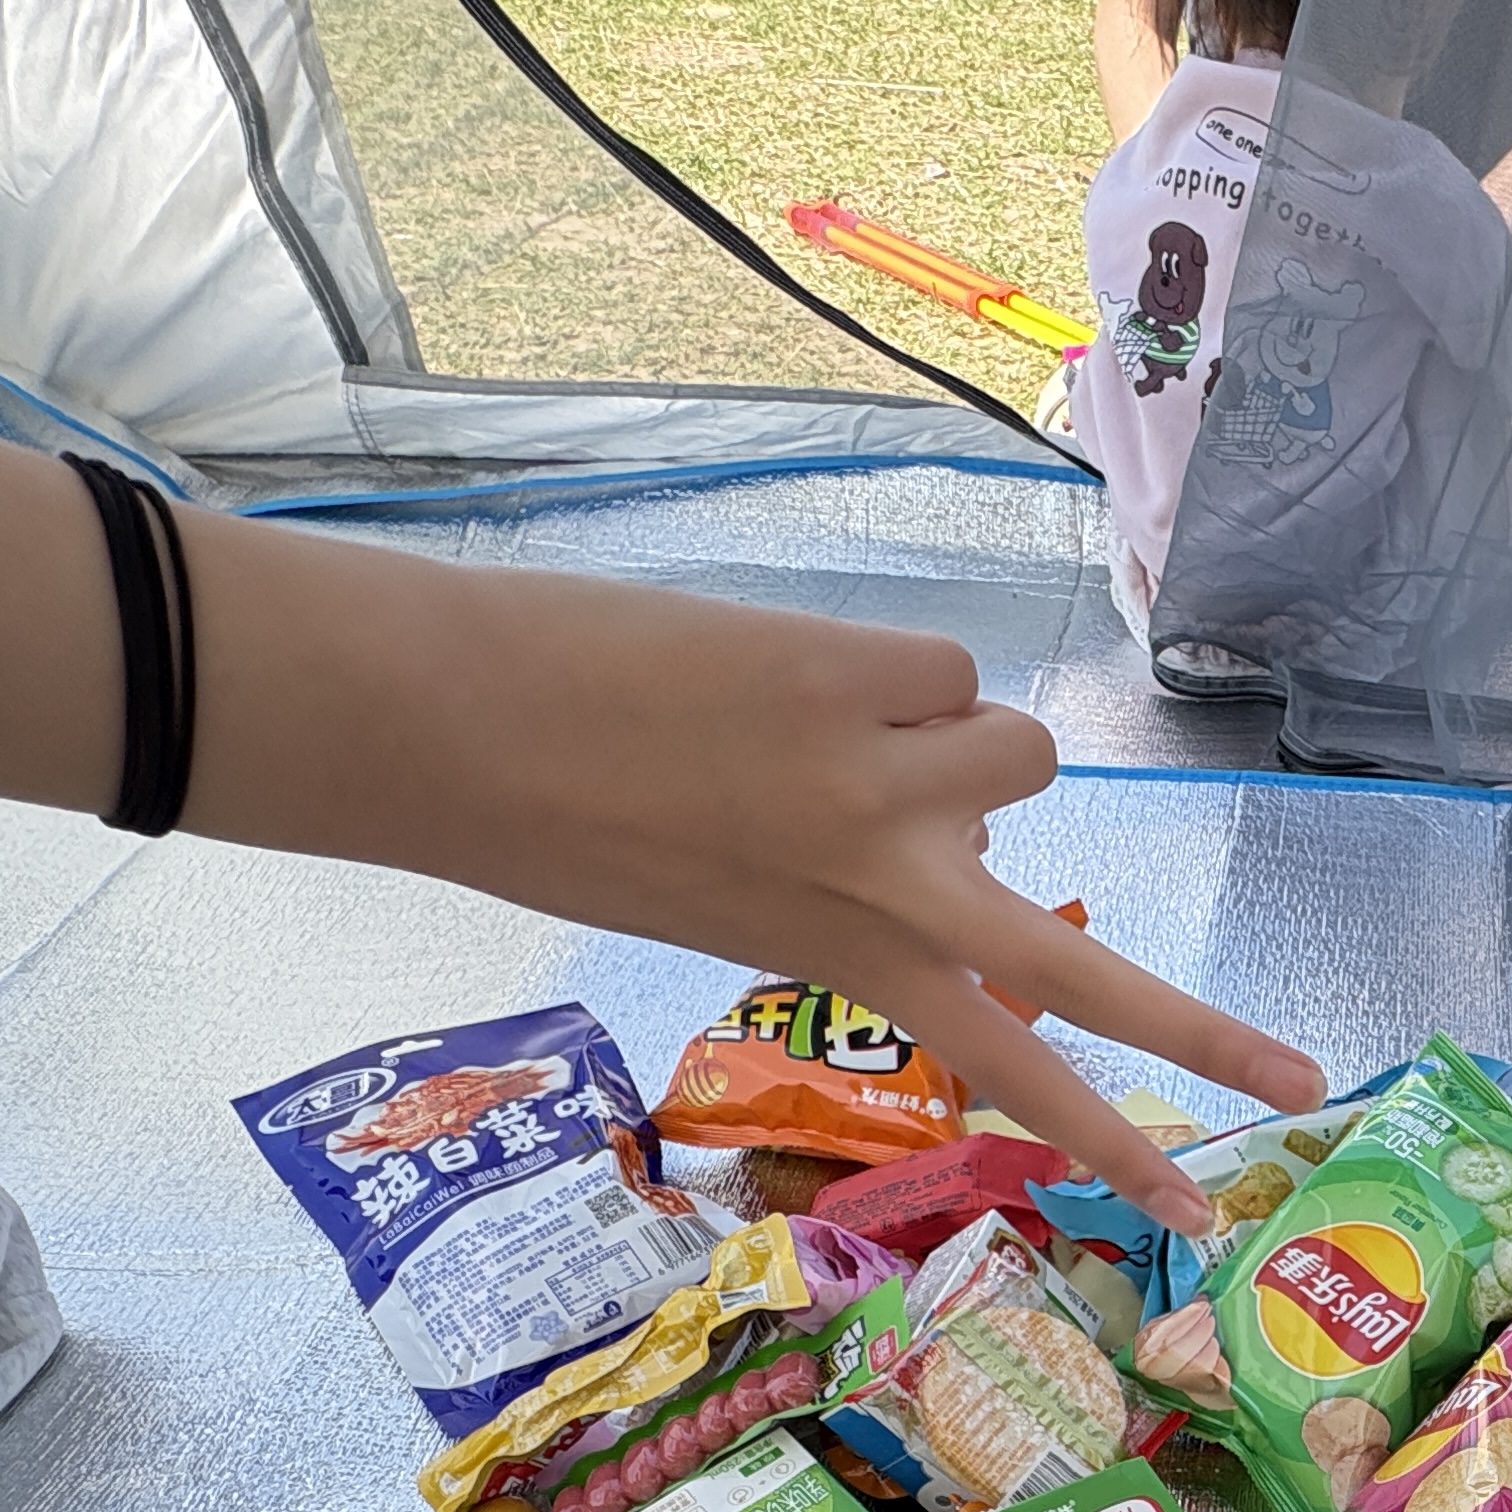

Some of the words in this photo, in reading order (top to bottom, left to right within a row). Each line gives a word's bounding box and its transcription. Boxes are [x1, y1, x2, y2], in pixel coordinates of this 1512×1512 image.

[1206, 119, 1232, 141] one
[1235, 135, 1264, 158] one
[351, 1084, 614, 1228] 辣白菜味
[1330, 1293, 1411, 1353] Lay's
